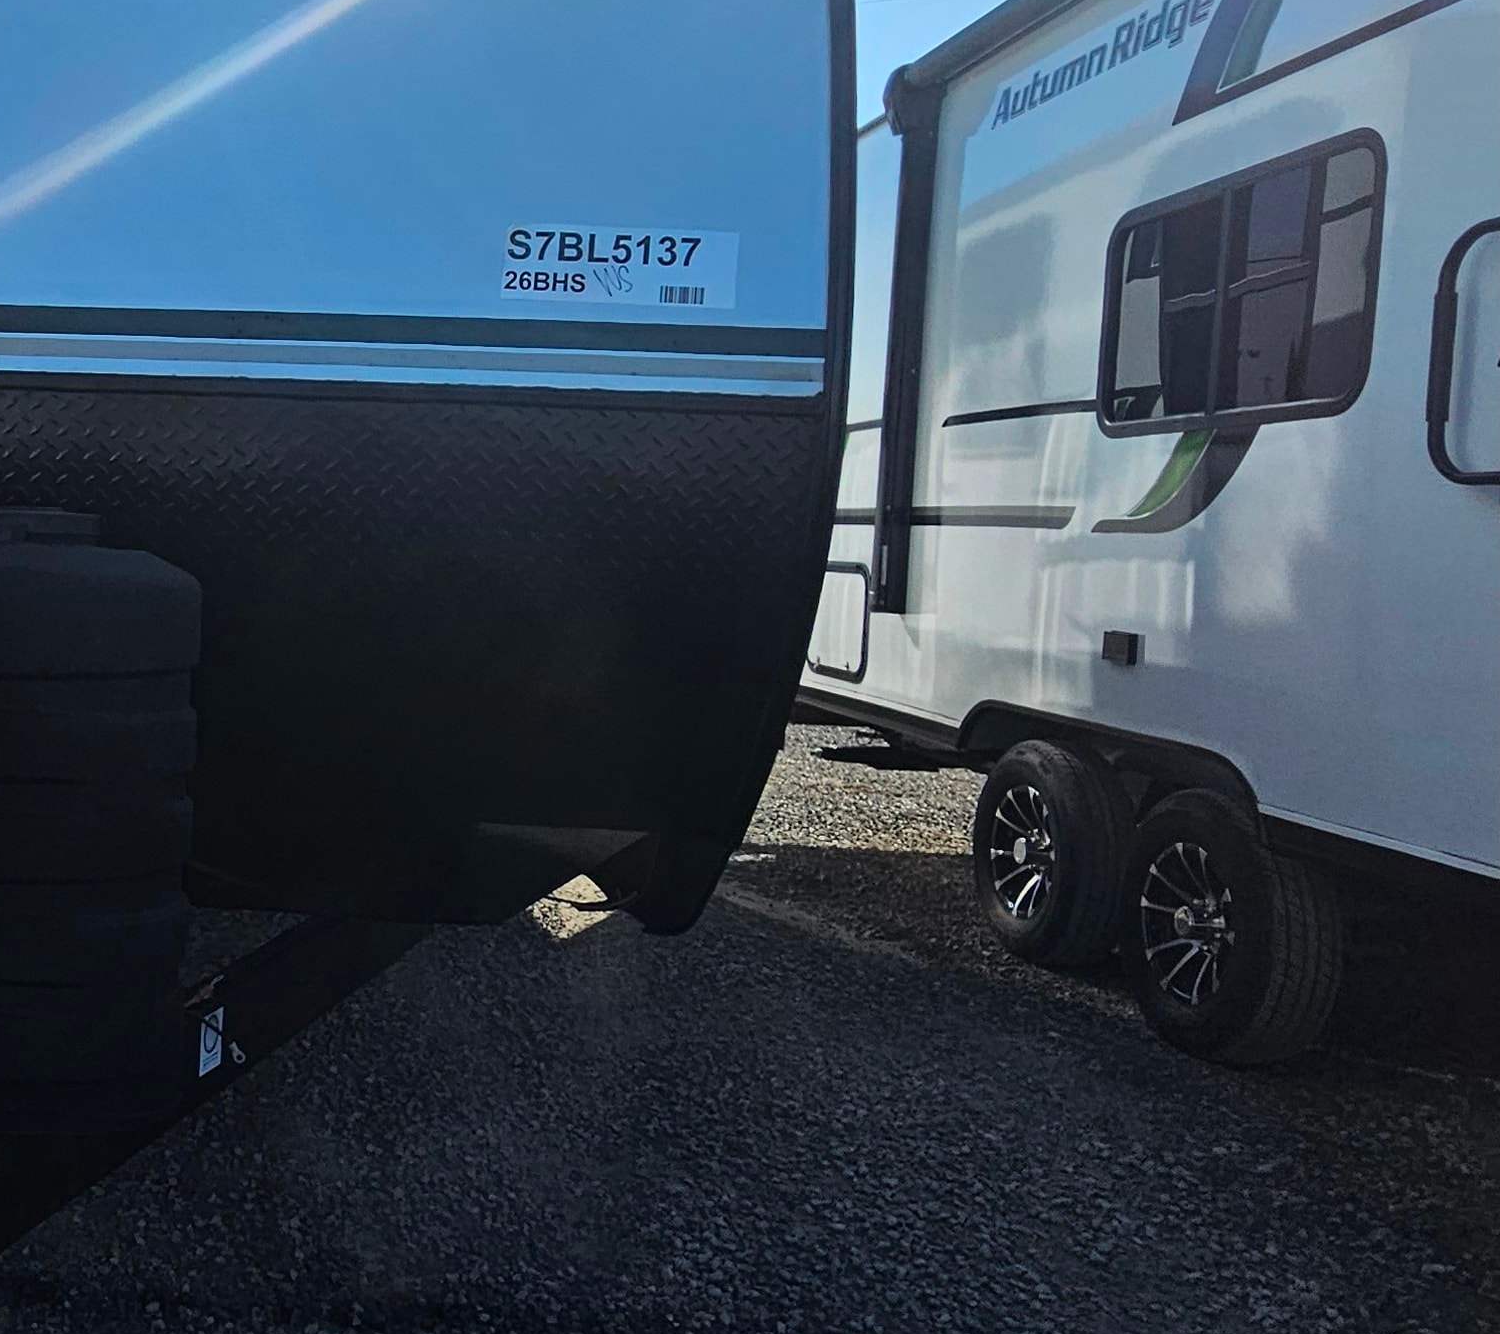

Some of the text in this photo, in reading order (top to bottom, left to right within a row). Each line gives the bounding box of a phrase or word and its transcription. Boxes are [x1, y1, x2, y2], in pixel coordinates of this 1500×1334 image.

[992, 43, 1108, 130] Autumn
[507, 229, 702, 267] S7BL5137
[504, 271, 586, 292] 26BHS
